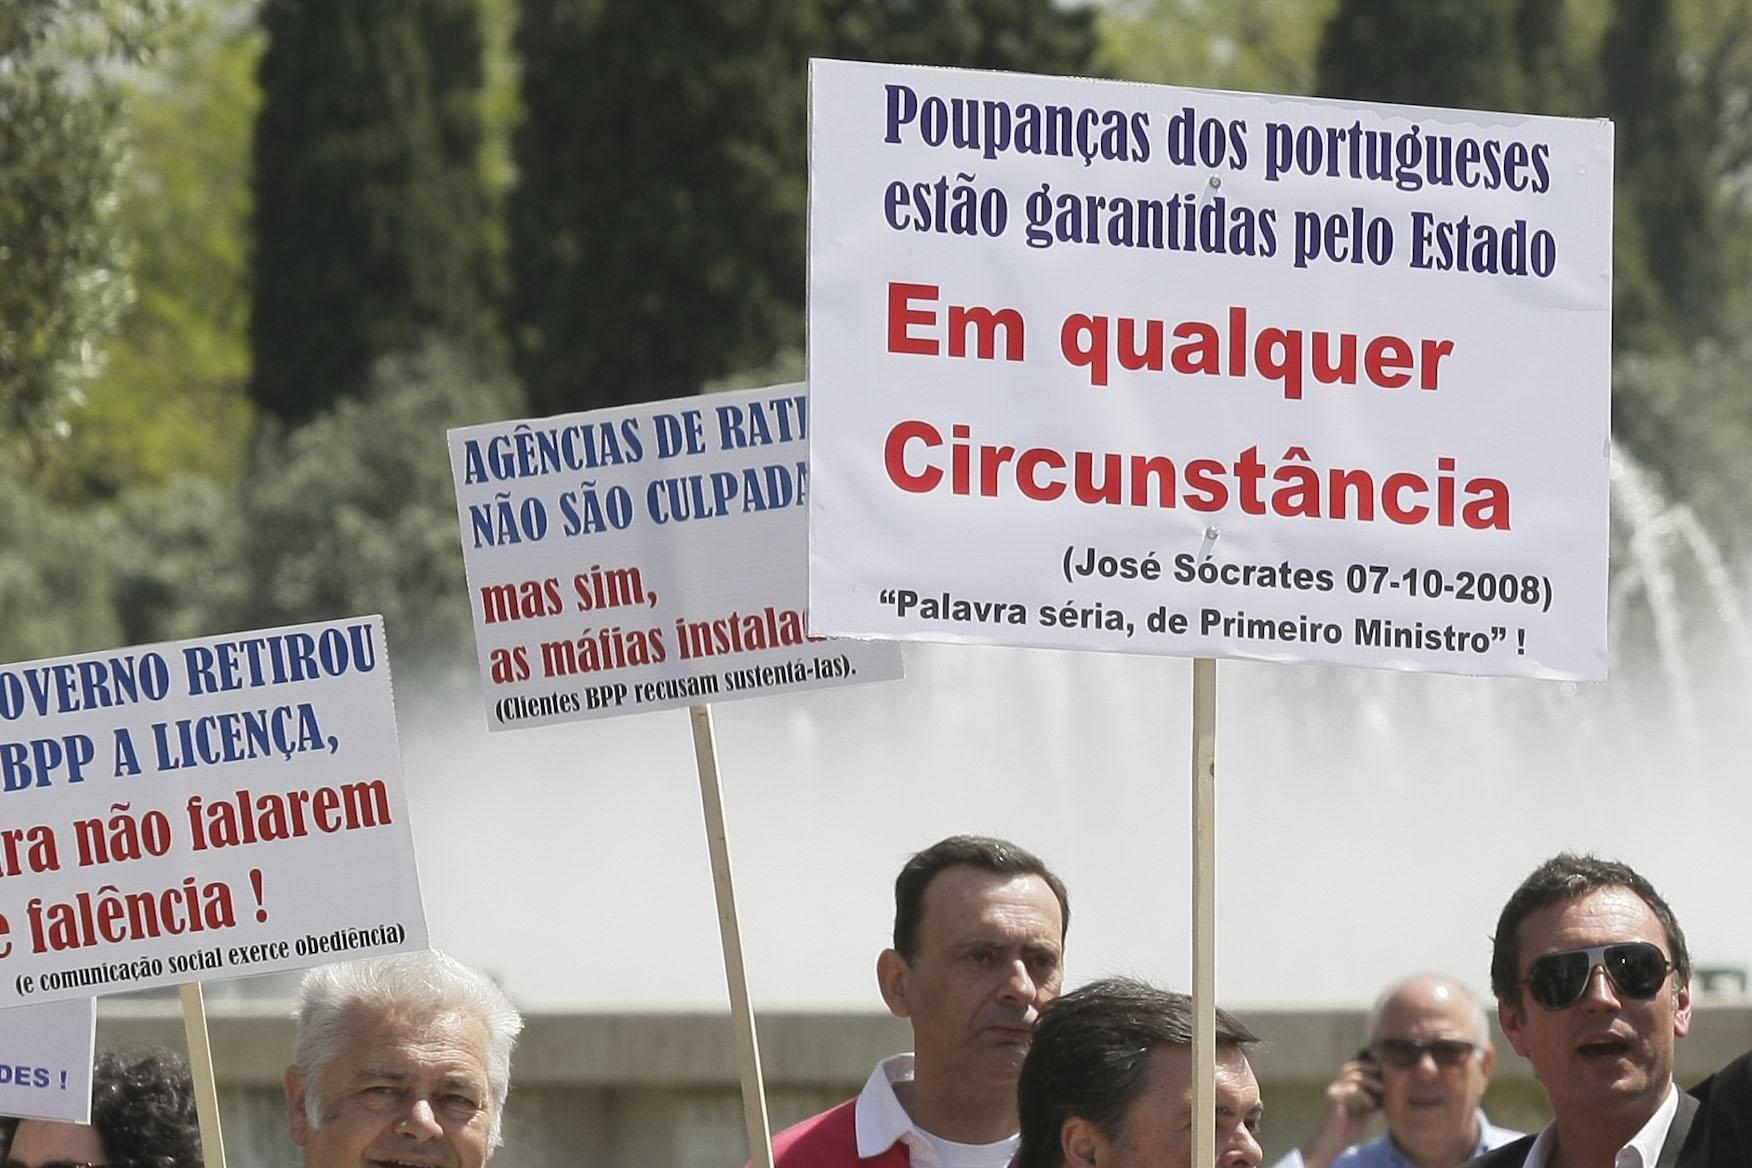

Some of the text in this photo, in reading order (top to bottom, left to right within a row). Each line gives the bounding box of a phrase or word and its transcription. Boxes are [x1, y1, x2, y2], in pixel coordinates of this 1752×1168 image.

[884, 84, 1549, 194] Poupanças dos portugueses
[884, 172, 1556, 278] estão garantidas pelo Estado
[888, 282, 1454, 400] Em qualquer
[464, 417, 644, 485] AGÊNCIAS
[653, 410, 706, 458] DE
[885, 421, 1511, 531] Circunstância
[469, 491, 547, 549] NÃO
[559, 479, 633, 538] SÃO
[480, 564, 657, 624] mas sim,
[1064, 546, 1552, 612] (José Sócrates 07-10-2008)
[489, 643, 530, 685] as
[541, 624, 667, 678] máfias
[880, 589, 1026, 624] “Palavra
[1039, 600, 1134, 638] séria,
[1147, 606, 1188, 634] de
[1201, 608, 1342, 644] Primeiro
[1355, 618, 1506, 653] Ministro”
[182, 624, 375, 696] RETIROU
[496, 653, 857, 724] (Clientes BPP recusam sustentá-las).
[113, 728, 142, 777] A
[151, 703, 338, 771] LICENÇA,
[73, 801, 171, 867] não
[187, 780, 392, 851] falarem
[26, 877, 236, 954] falência
[16, 923, 405, 996] (e comunicação social exerce obediência)
